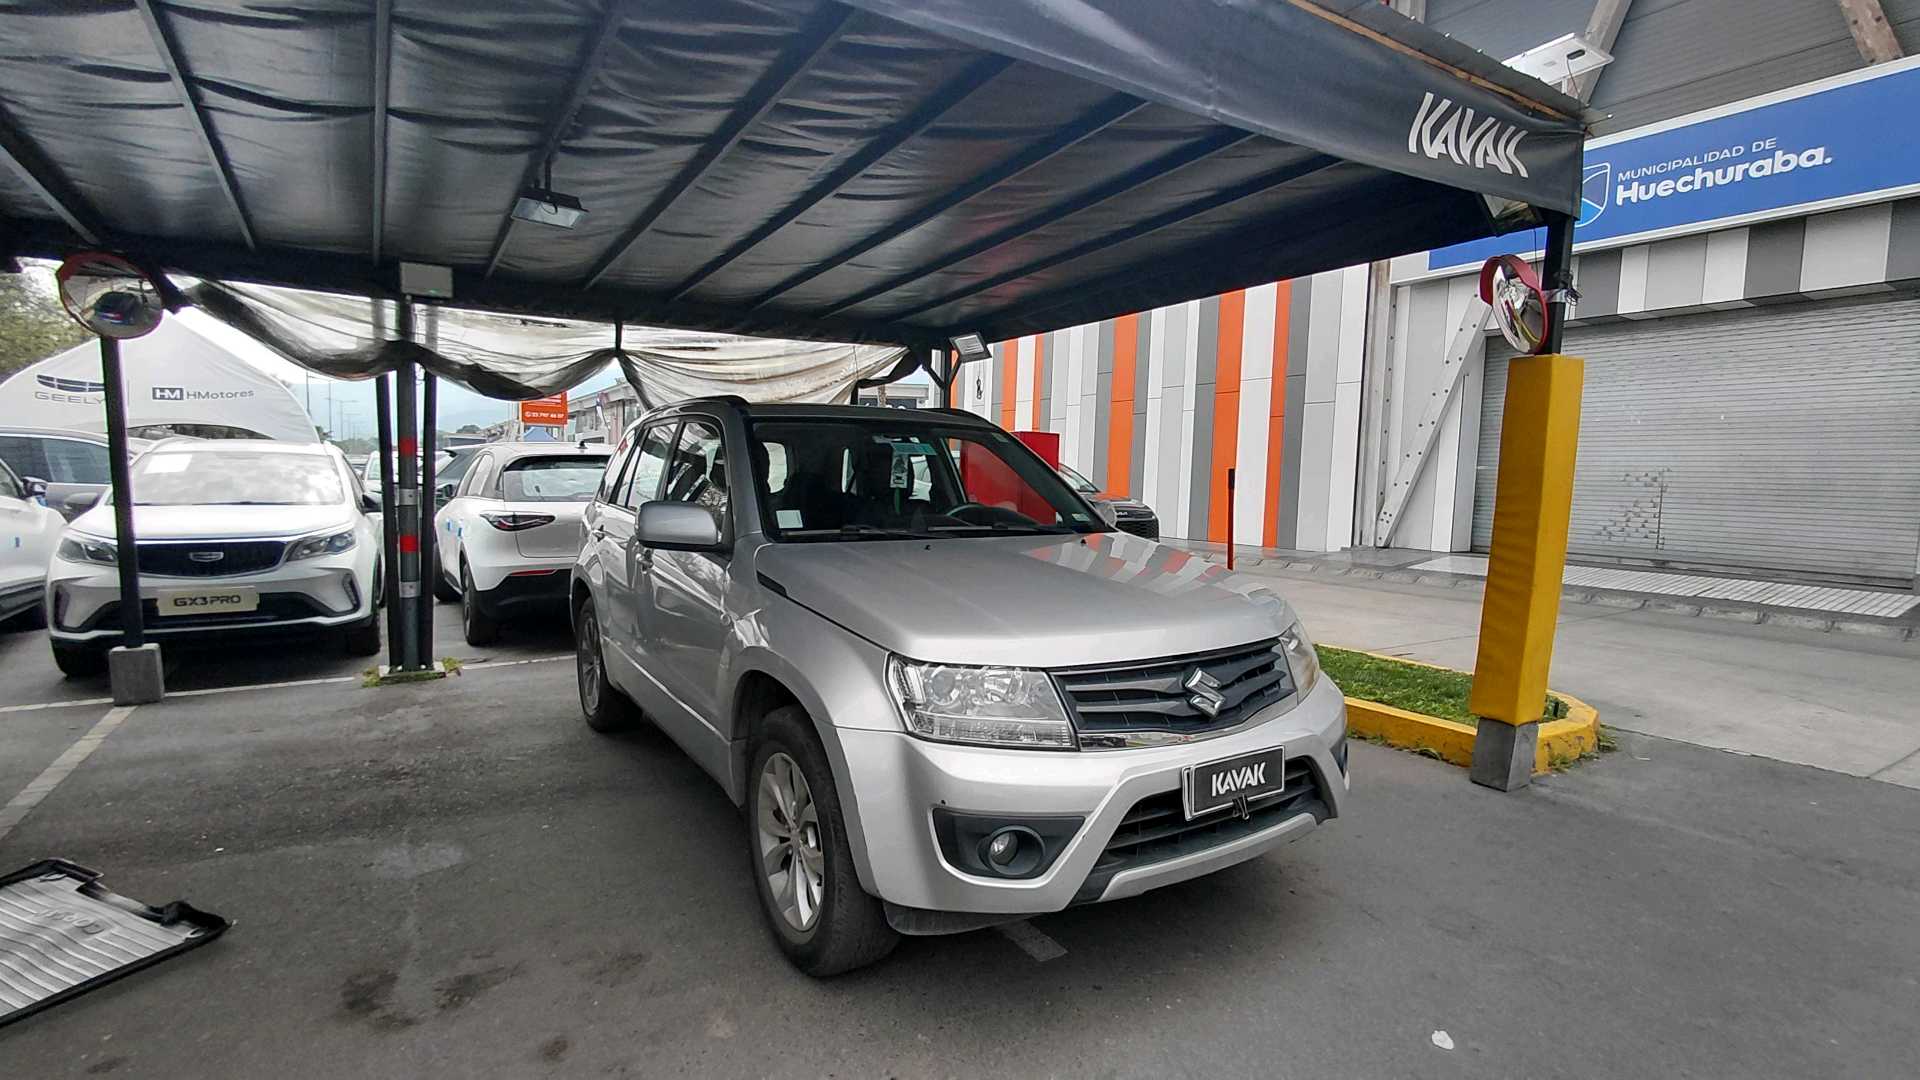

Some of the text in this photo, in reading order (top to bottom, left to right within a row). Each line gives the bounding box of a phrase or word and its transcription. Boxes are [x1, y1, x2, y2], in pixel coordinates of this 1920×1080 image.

[1408, 91, 1529, 178] KAVAK
[1616, 146, 1833, 206] Huechuraba.
[1617, 137, 1777, 182] MUNICIPALIDAD DE
[34, 391, 104, 405] GEELY
[155, 388, 181, 399] HM
[186, 390, 255, 400] HMotores
[1211, 761, 1266, 797] KAVAK
